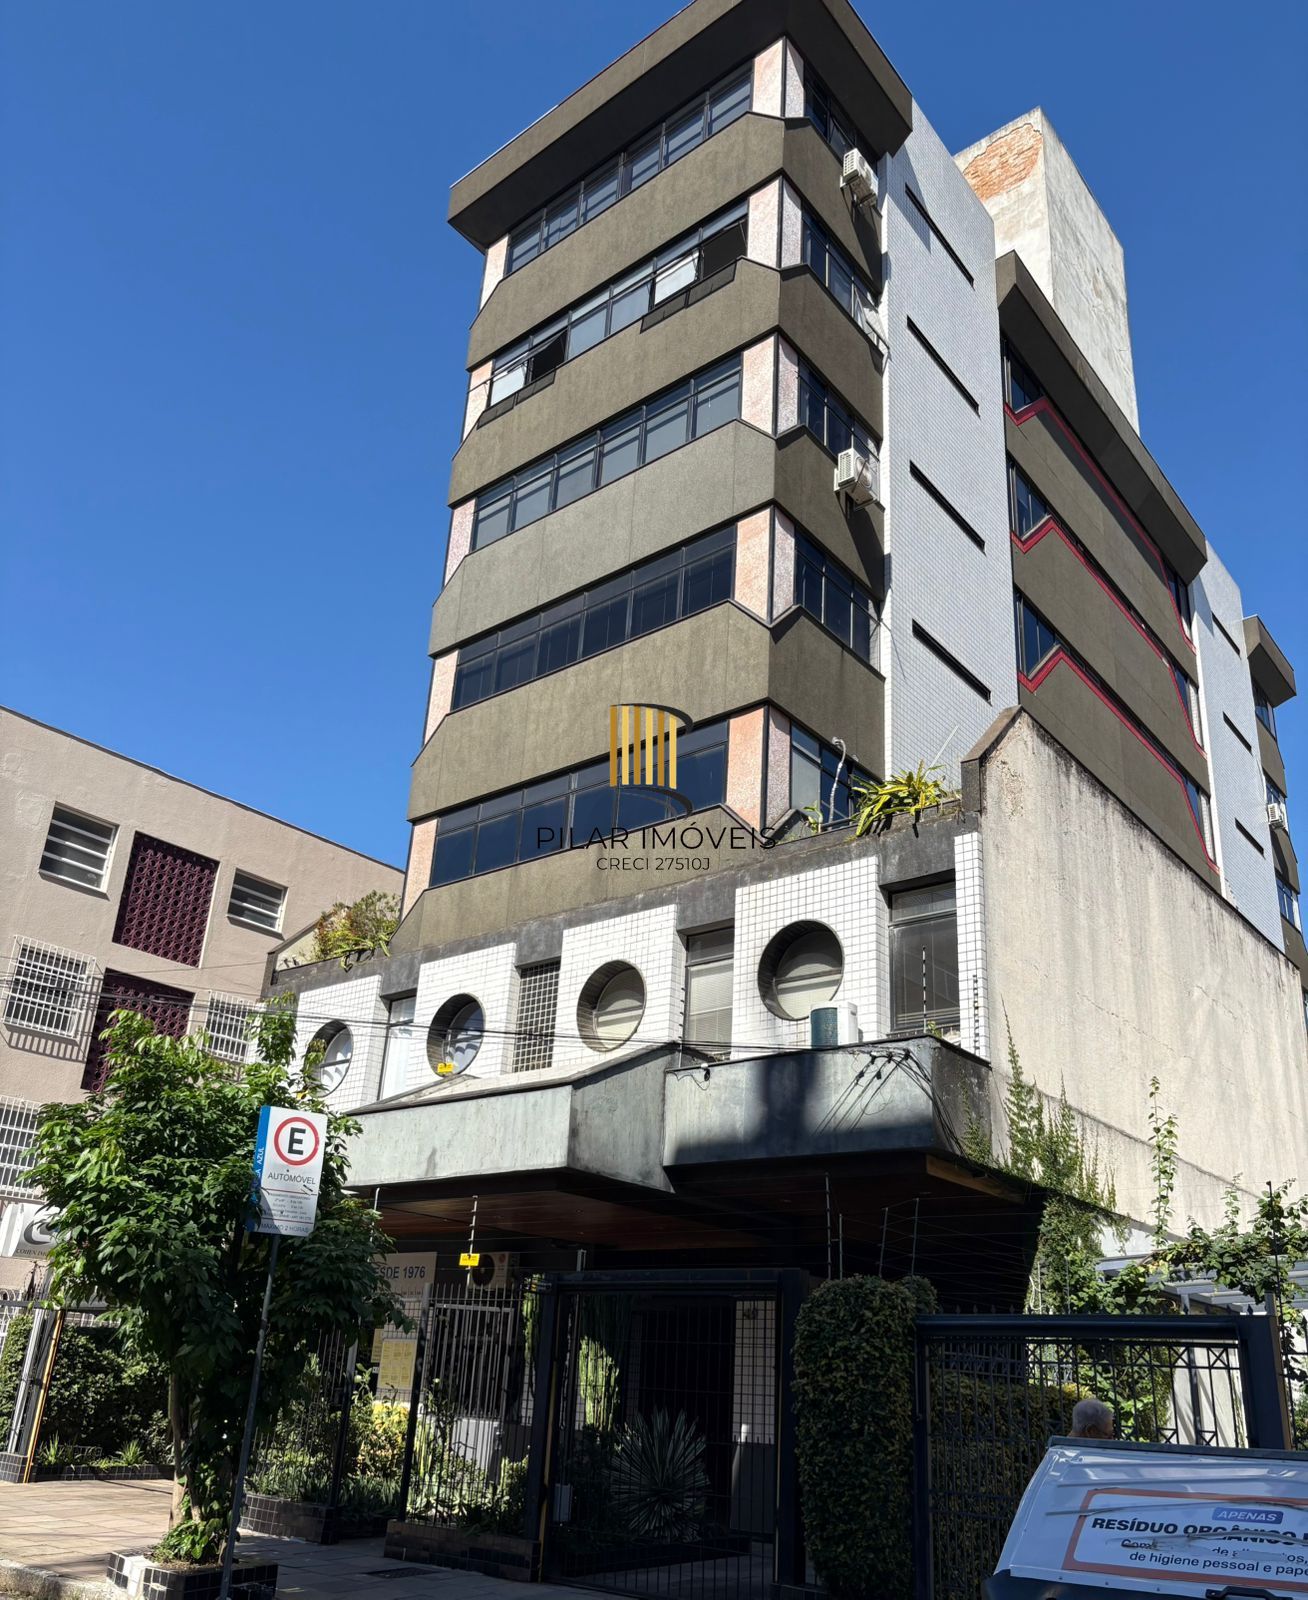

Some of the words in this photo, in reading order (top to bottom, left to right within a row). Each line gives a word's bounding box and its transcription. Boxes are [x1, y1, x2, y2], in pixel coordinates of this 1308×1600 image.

[287, 1126, 307, 1156] E
[256, 1146, 265, 1165] AZUL
[267, 1171, 316, 1185] AUTOMÓVEL
[374, 1265, 400, 1279] ESDE
[403, 1264, 426, 1278] 1976
[1217, 1510, 1277, 1521] APENAS
[1091, 1517, 1179, 1534] RESÍDUO
[1129, 1551, 1146, 1562] de
[1149, 1552, 1199, 1567] higiene
[1202, 1559, 1260, 1572] pessoal
[1263, 1563, 1272, 1573] e
